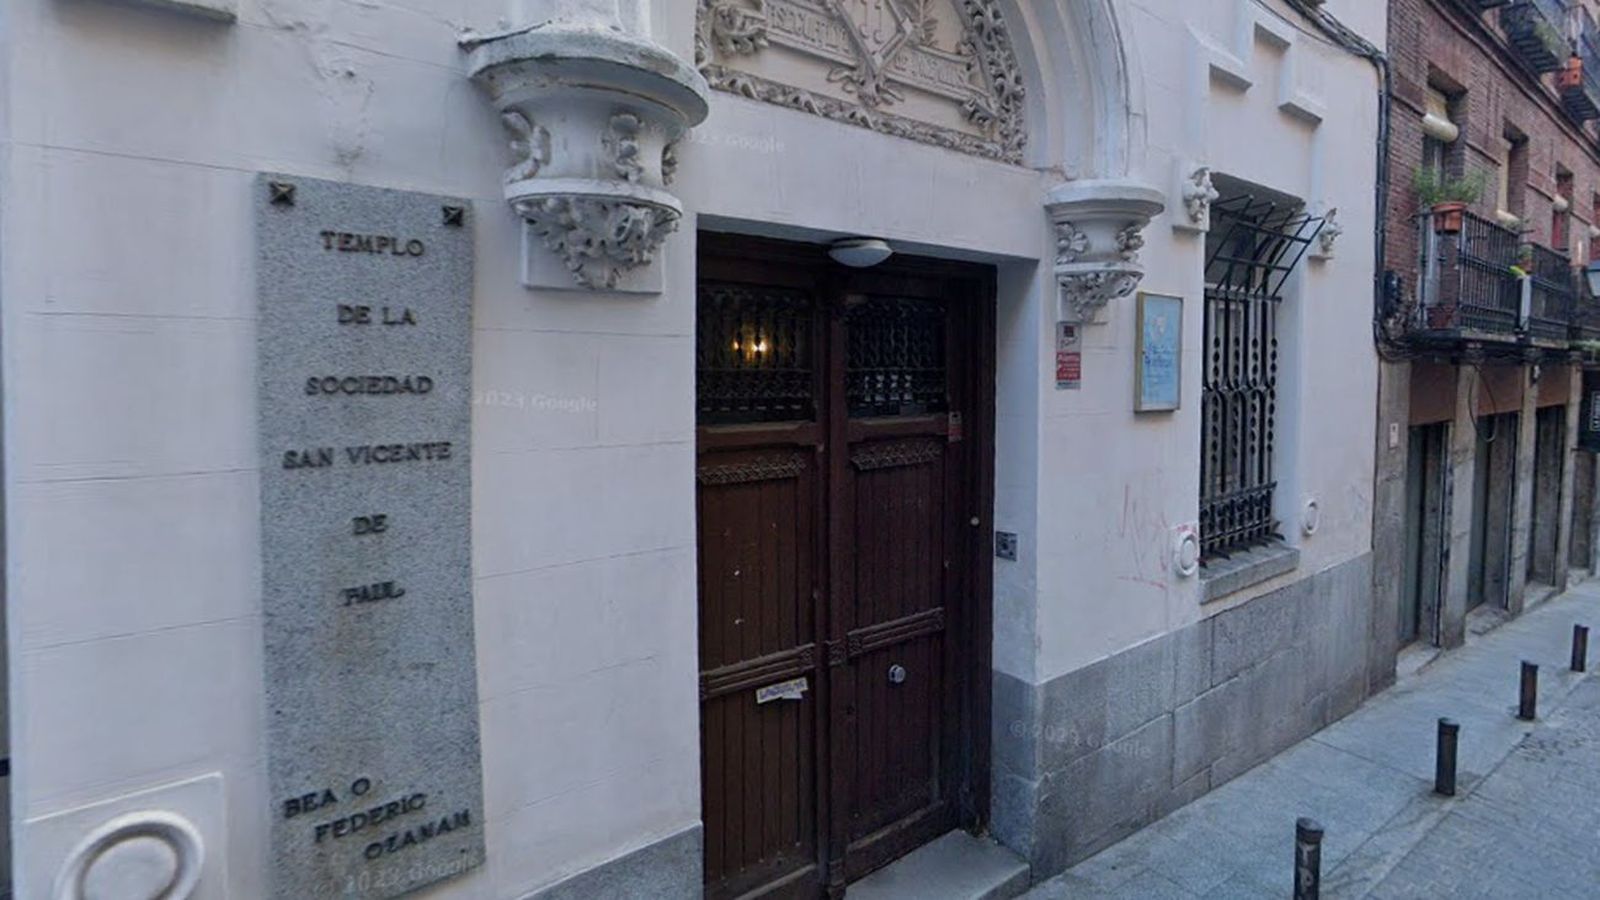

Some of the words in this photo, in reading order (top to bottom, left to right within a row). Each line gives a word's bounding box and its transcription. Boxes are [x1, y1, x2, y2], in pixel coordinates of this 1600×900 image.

[320, 230, 425, 257] TEMPLO
[337, 303, 372, 325] DE
[382, 306, 416, 326] LA
[305, 375, 434, 397] SOCIEDAD
[282, 446, 334, 470] SAN
[346, 441, 452, 466] VICENTE
[352, 514, 388, 535] DE
[283, 788, 338, 819] BEA
[350, 777, 371, 797] O
[313, 793, 429, 843] FEDERIC
[363, 808, 472, 861] OZANAM
